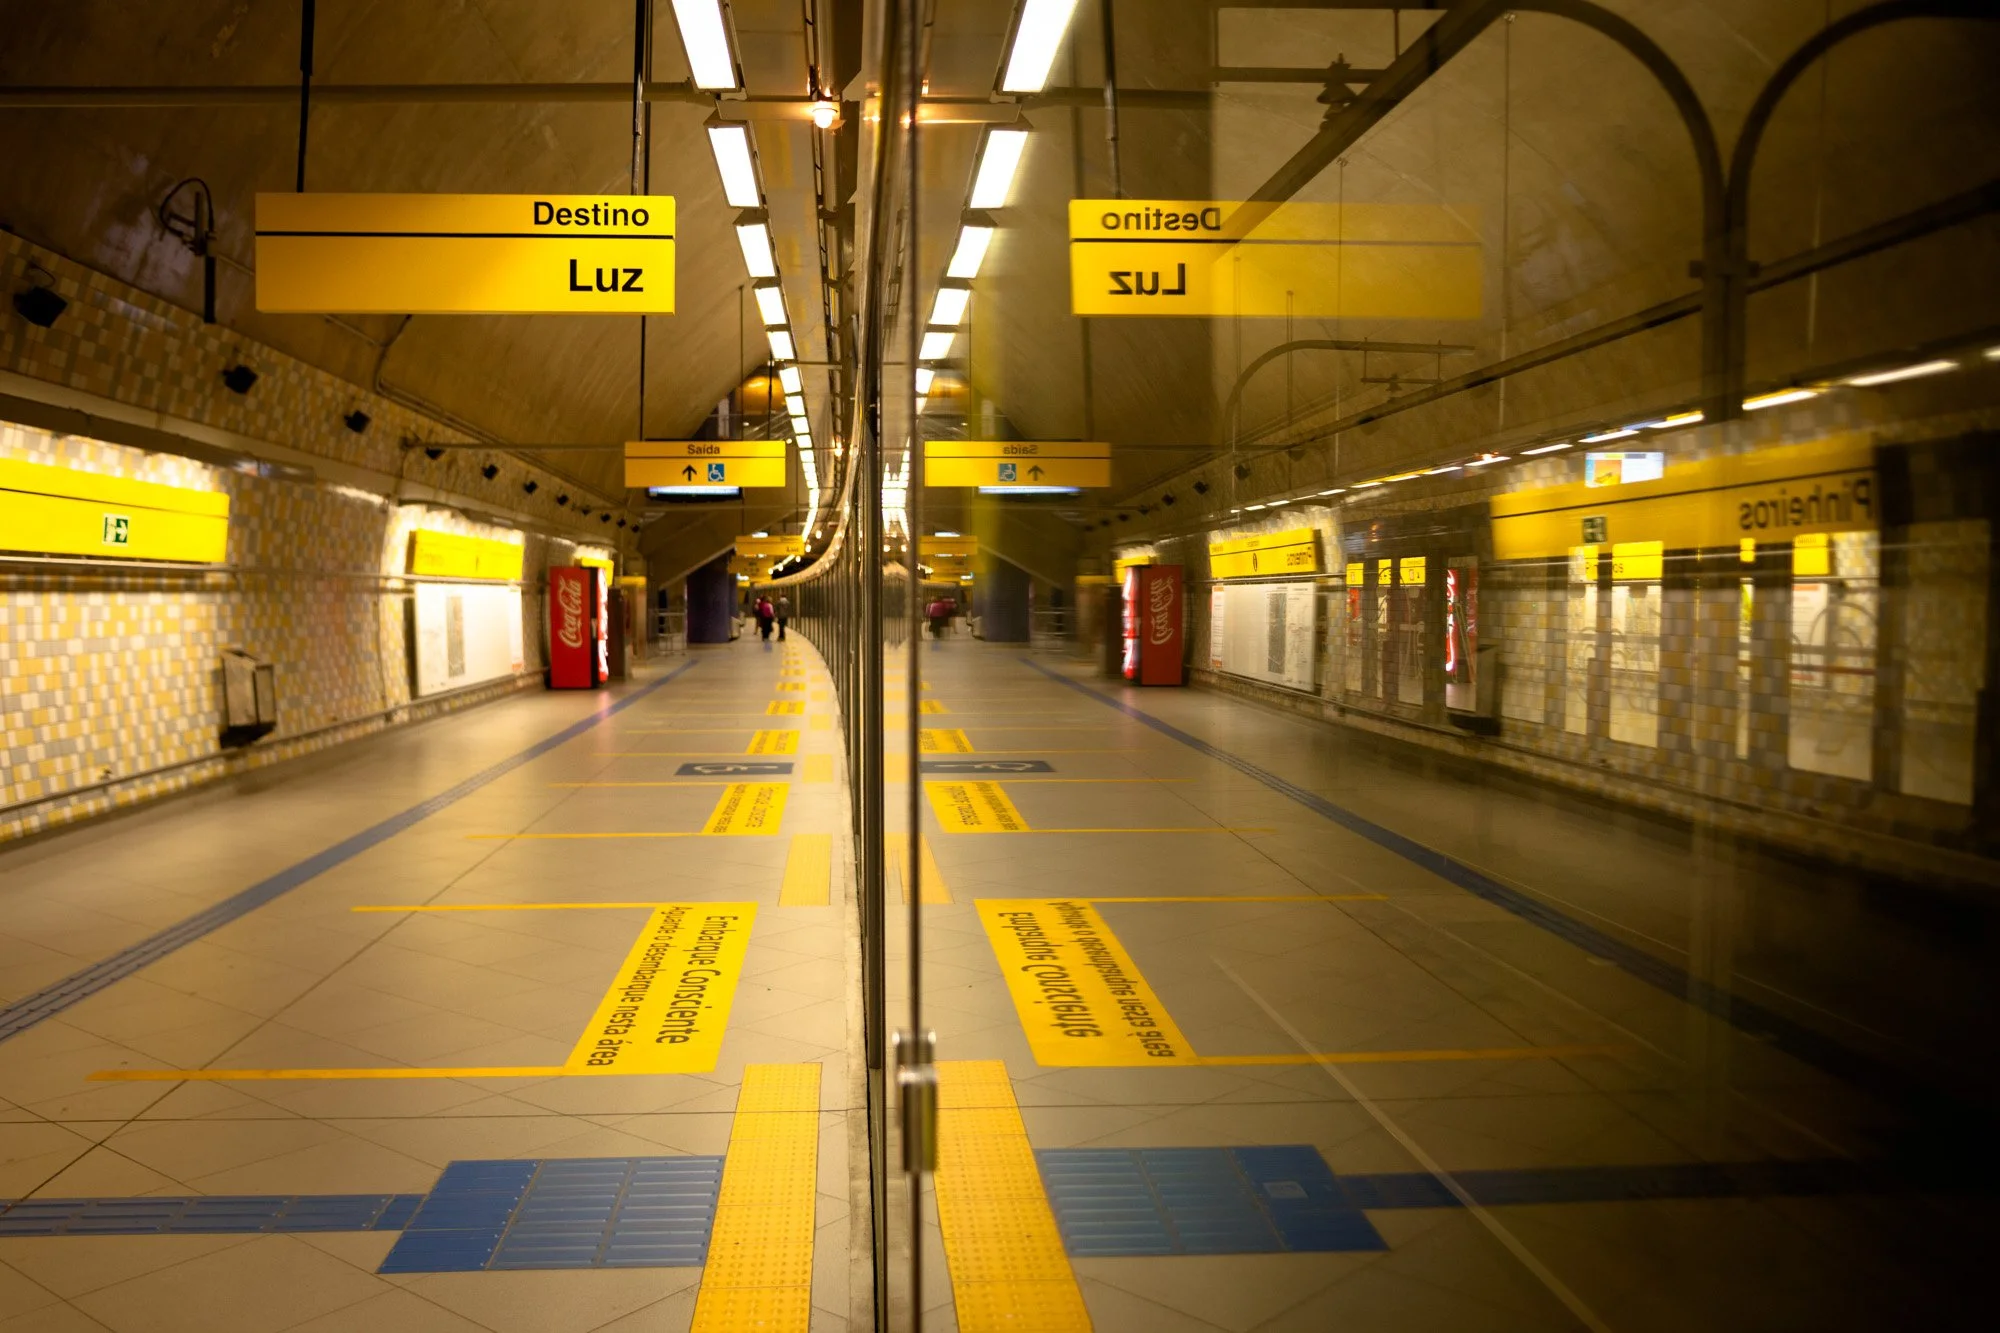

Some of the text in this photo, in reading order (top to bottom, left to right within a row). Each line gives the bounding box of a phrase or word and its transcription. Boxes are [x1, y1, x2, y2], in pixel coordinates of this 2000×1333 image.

[533, 201, 650, 227] Destino
[569, 258, 644, 292] Luz
[687, 443, 721, 455] Saída
[657, 905, 694, 934] Aguarde
[617, 942, 678, 1003] desembarque
[655, 915, 739, 1044] Embarque Consciente
[602, 1005, 640, 1036] nesta
[586, 1038, 633, 1067] área
